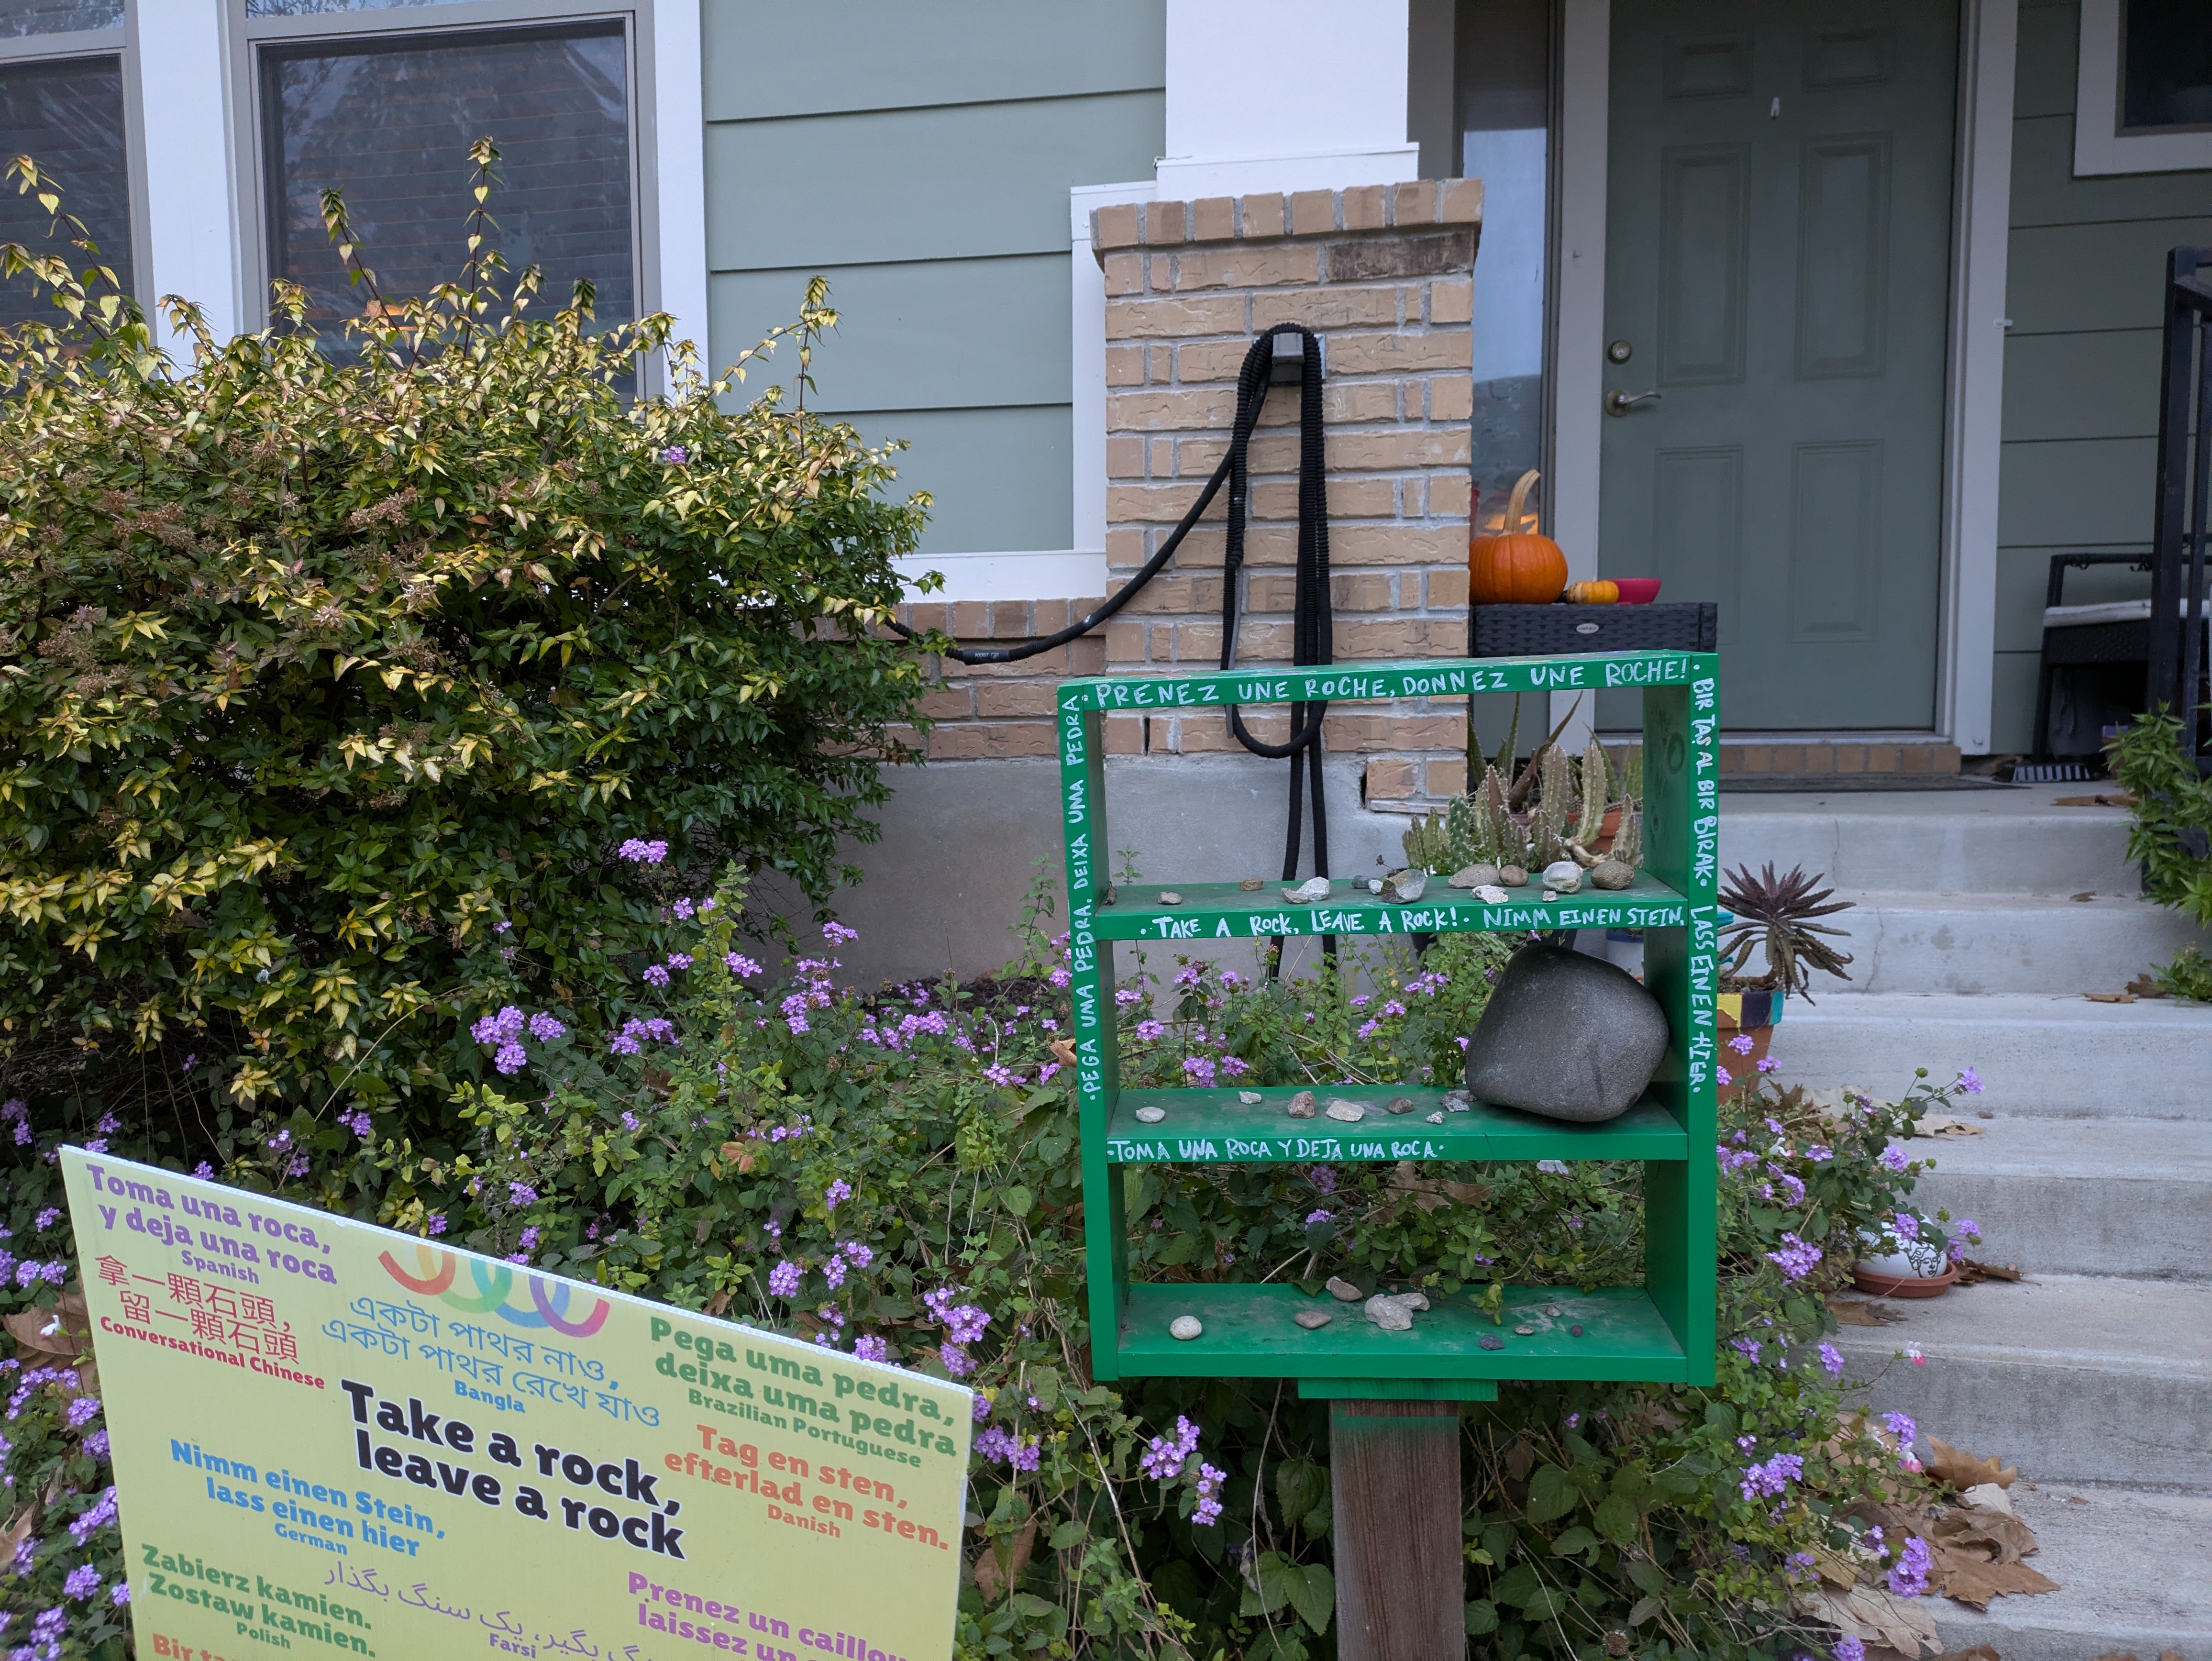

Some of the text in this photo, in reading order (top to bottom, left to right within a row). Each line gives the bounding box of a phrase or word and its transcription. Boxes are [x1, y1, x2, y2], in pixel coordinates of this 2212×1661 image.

[1096, 660, 1687, 708] PRENEZ UNE ROCHE, DONNEZ UNE ROCHE!
[1695, 752, 1713, 775] AL
[1068, 779, 1085, 823] UMA
[1697, 780, 1715, 809] BIR
[1071, 833, 1089, 890] DEIXA
[1152, 907, 1458, 939] TAKE A ROCK, LEAVE A ROCK!
[1483, 908, 1551, 928] NIMM
[1559, 908, 1621, 926] EINEN
[1691, 905, 1715, 951] LASS
[1075, 984, 1095, 1028] UMA
[1691, 955, 1714, 1027] EINEN
[1080, 1038, 1101, 1092] PEGA
[1178, 1139, 1218, 1160] UNA
[1226, 1138, 1271, 1158] ROCA
[1278, 1139, 1293, 1158] Y
[1296, 1139, 1344, 1160] DEJA
[1350, 1143, 1386, 1159] UNA
[1391, 1141, 1438, 1159] ROCA
[86, 1163, 332, 1255] Toma una roca,
[98, 1201, 337, 1285] y deja una roca
[181, 1249, 260, 1285] Spanish
[100, 1316, 326, 1390] Conversational Chinese
[120, 1289, 300, 1365] 留一顆石頭
[350, 1296, 619, 1391] একটা পাথর নাও,
[322, 1319, 661, 1428] একটা পাথর রেখে যাও
[454, 1380, 526, 1414] Bangla
[651, 1316, 956, 1427] Pega uma pedra,
[655, 1352, 957, 1457] deixa uma pedra
[688, 1388, 922, 1468] Brazilian Portuguese
[341, 1378, 682, 1517] Take a rock,
[697, 1424, 908, 1509] Tag en sten,
[170, 1438, 445, 1539] Nimm einen Stein,
[206, 1476, 420, 1557] lass einen hier
[355, 1429, 686, 1561] leave a rock
[664, 1451, 949, 1551] efterlad en sten.
[274, 1523, 348, 1556] German
[767, 1504, 841, 1539] Danish
[141, 1543, 372, 1630] Zabierz kamien.
[324, 1560, 389, 1602] بگذار
[398, 1583, 471, 1620] سنگ
[628, 1571, 740, 1625] Prenez
[749, 1612, 789, 1639] un
[148, 1572, 376, 1658] Zostaw kamien.
[236, 1622, 291, 1650] Polish
[638, 1603, 748, 1656] laissez
[757, 1643, 797, 1661] un
[153, 1633, 193, 1661] Bir
[489, 1632, 536, 1659] Farsi
